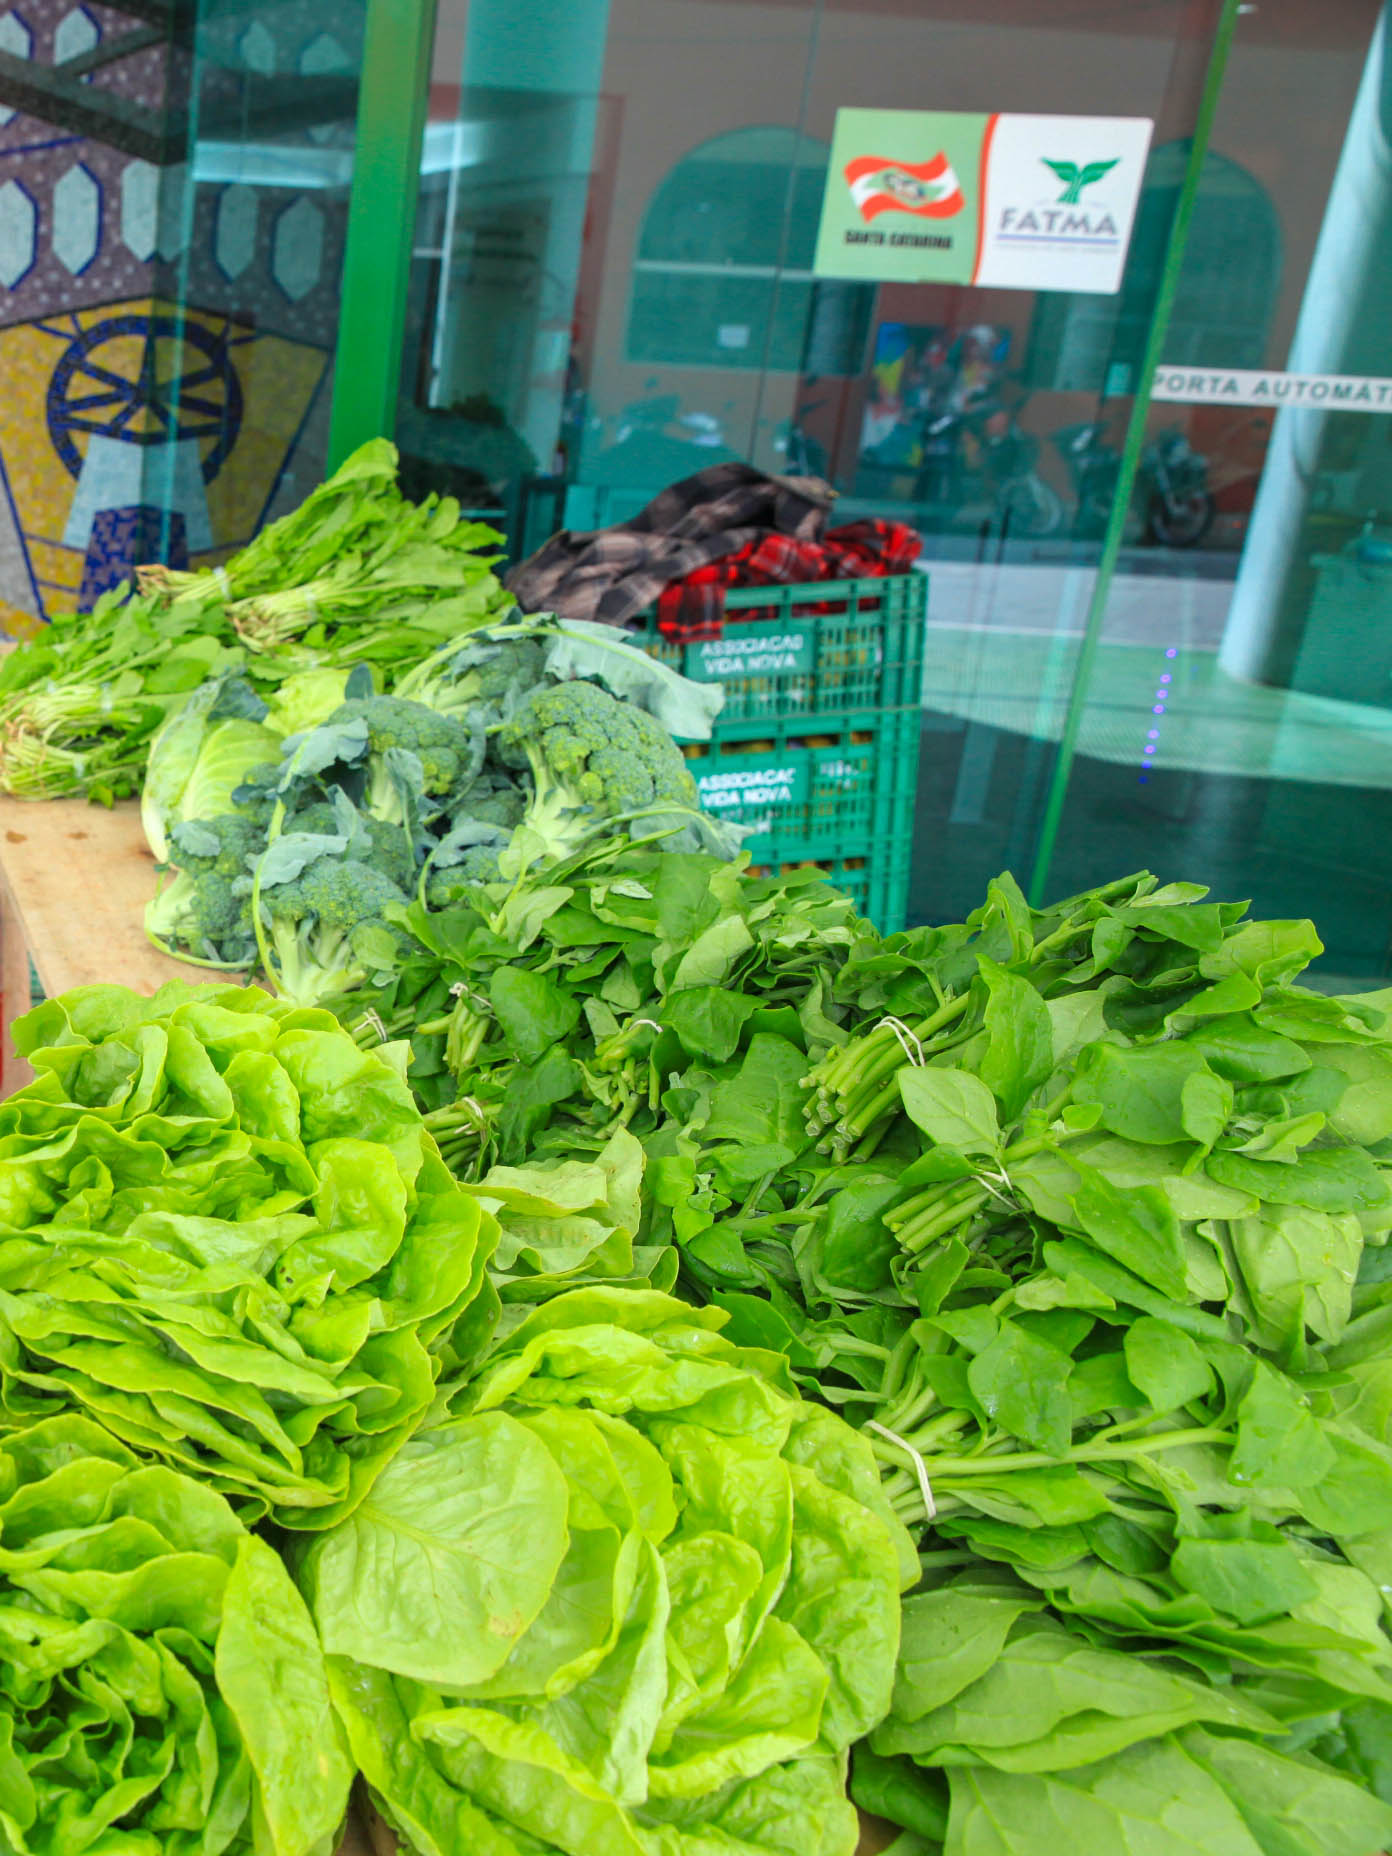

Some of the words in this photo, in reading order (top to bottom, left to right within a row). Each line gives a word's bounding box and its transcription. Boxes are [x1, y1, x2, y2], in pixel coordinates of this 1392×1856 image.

[999, 207, 1117, 235] FATMA
[845, 229, 884, 245] SANTA
[889, 231, 952, 250] CATARINA
[1251, 379, 1392, 403] AUTOMÁT
[704, 656, 744, 674] VIDA
[747, 653, 797, 671] NOVA
[701, 790, 740, 807] VIDA
[743, 785, 792, 803] NOVA
